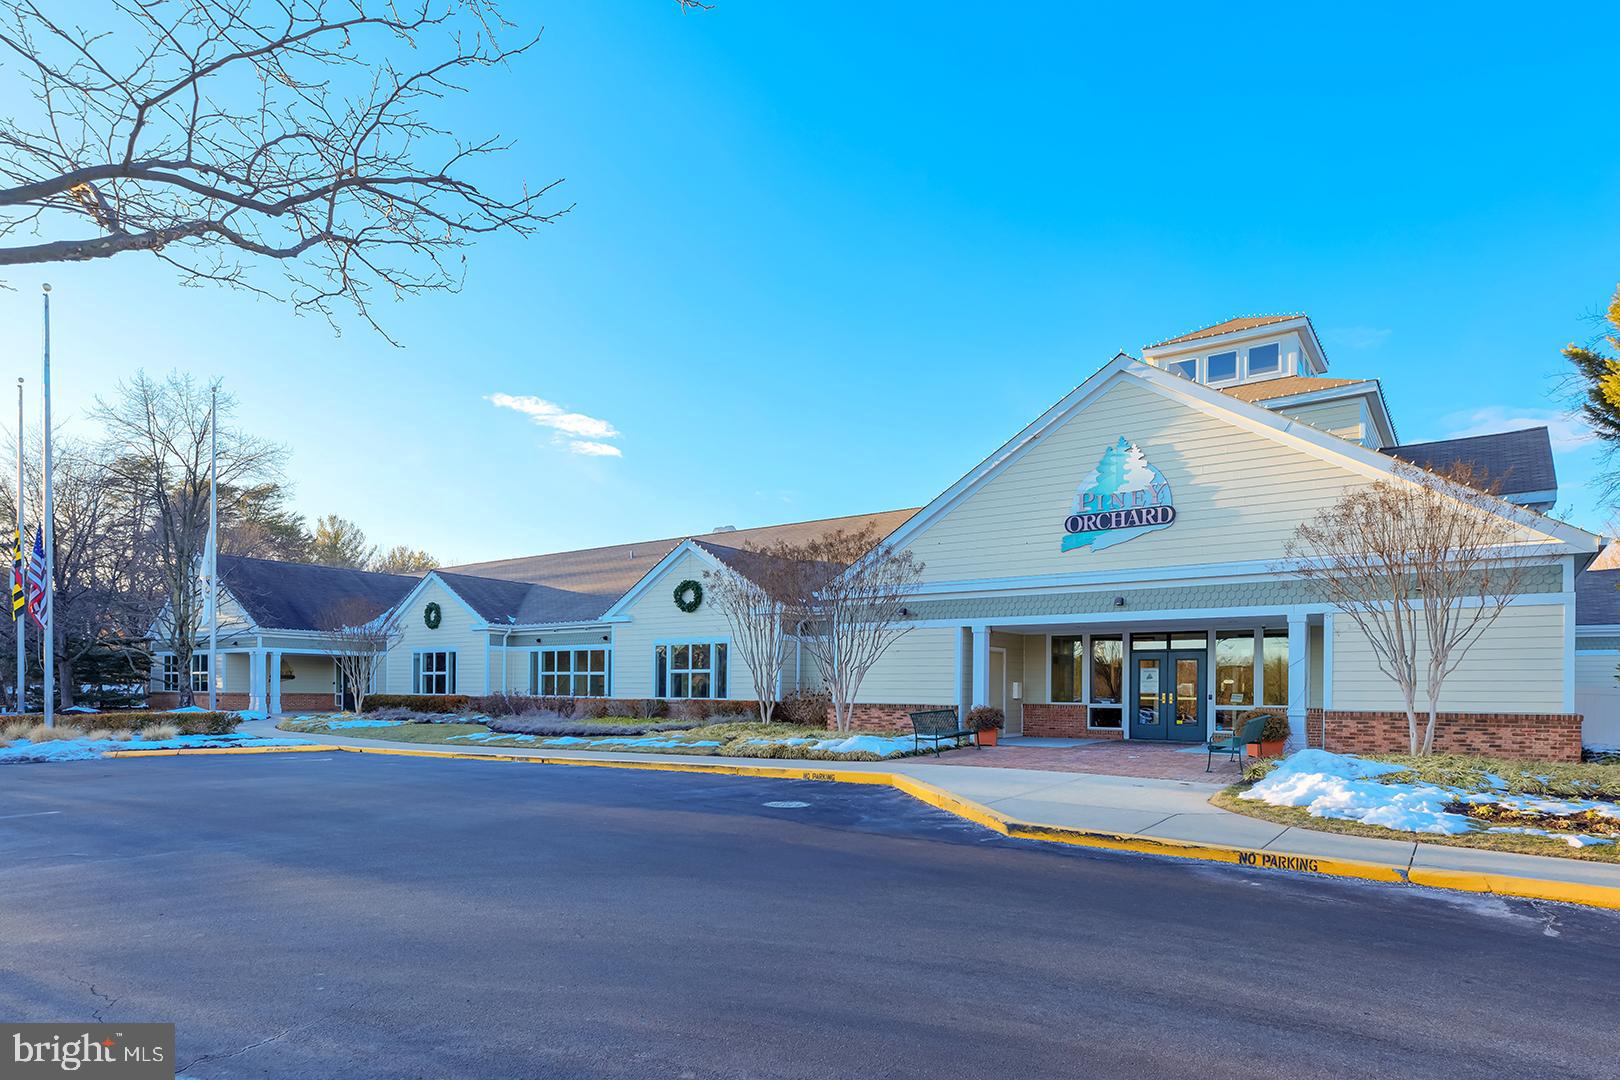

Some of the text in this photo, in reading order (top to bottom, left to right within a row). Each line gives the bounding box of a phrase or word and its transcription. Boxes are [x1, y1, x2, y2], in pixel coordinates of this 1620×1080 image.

[1076, 481, 1169, 514] PINEY
[1066, 506, 1174, 533] ORCHARD
[803, 772, 836, 781] NO PARKING
[1239, 851, 1318, 872] NO PARKING
